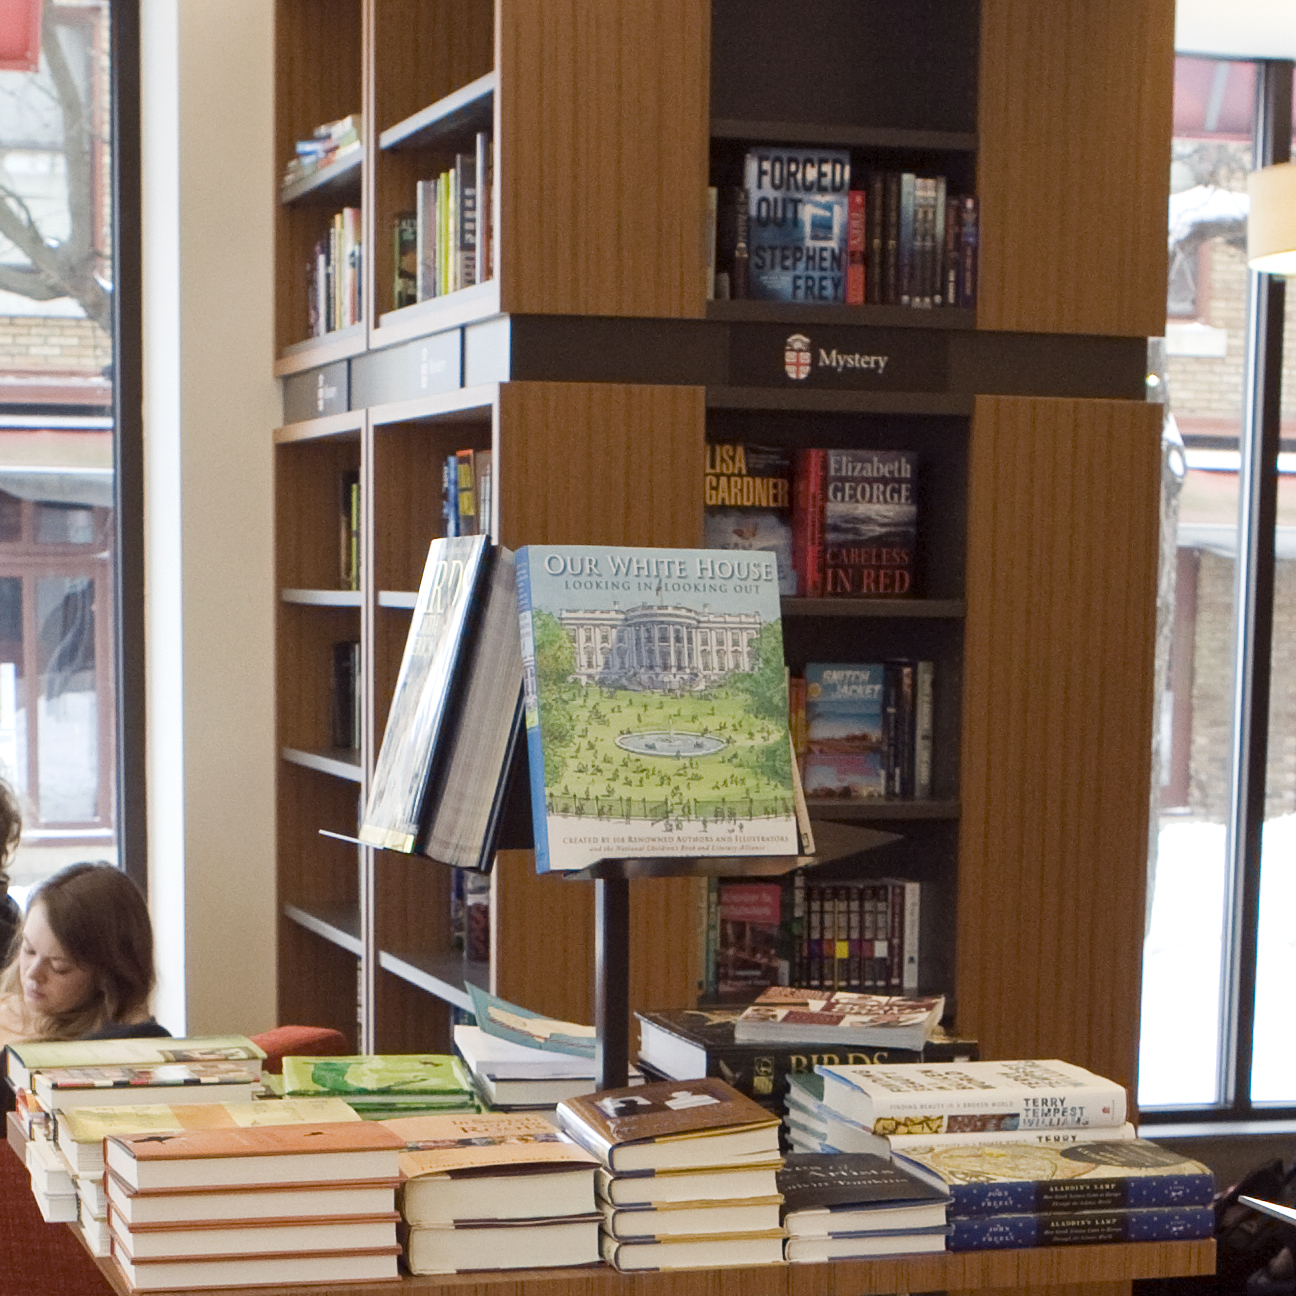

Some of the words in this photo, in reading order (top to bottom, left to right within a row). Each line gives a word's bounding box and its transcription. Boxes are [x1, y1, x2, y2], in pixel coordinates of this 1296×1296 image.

[757, 155, 846, 193] FORCED
[757, 197, 802, 227] OUT
[755, 244, 842, 271] STEPHEN
[793, 274, 842, 300] FREY
[819, 349, 888, 373] Mystery
[706, 445, 746, 474] LISA
[830, 456, 911, 478] Elizabeth
[706, 476, 789, 507] GARDNER
[829, 482, 912, 503] GEORGE
[544, 554, 602, 577] OUR
[607, 555, 688, 579] WHITE
[695, 557, 773, 581] HOUSE
[826, 548, 909, 565] CARELESS
[565, 581, 631, 591] LOOKING
[637, 582, 652, 592] IN
[664, 582, 728, 594] LOOKING
[733, 584, 760, 595] OUT
[827, 570, 852, 593] IN
[863, 570, 910, 593] RED
[627, 836, 674, 844] RENOWNED
[676, 835, 713, 843] AUTHORS
[735, 836, 789, 844] ILLUSTRATORS
[790, 1051, 888, 1074] BIRDS
[1023, 1097, 1066, 1108] TERRY
[1023, 1107, 1085, 1118] TEMPEST
[1093, 1183, 1116, 1192] LAMP
